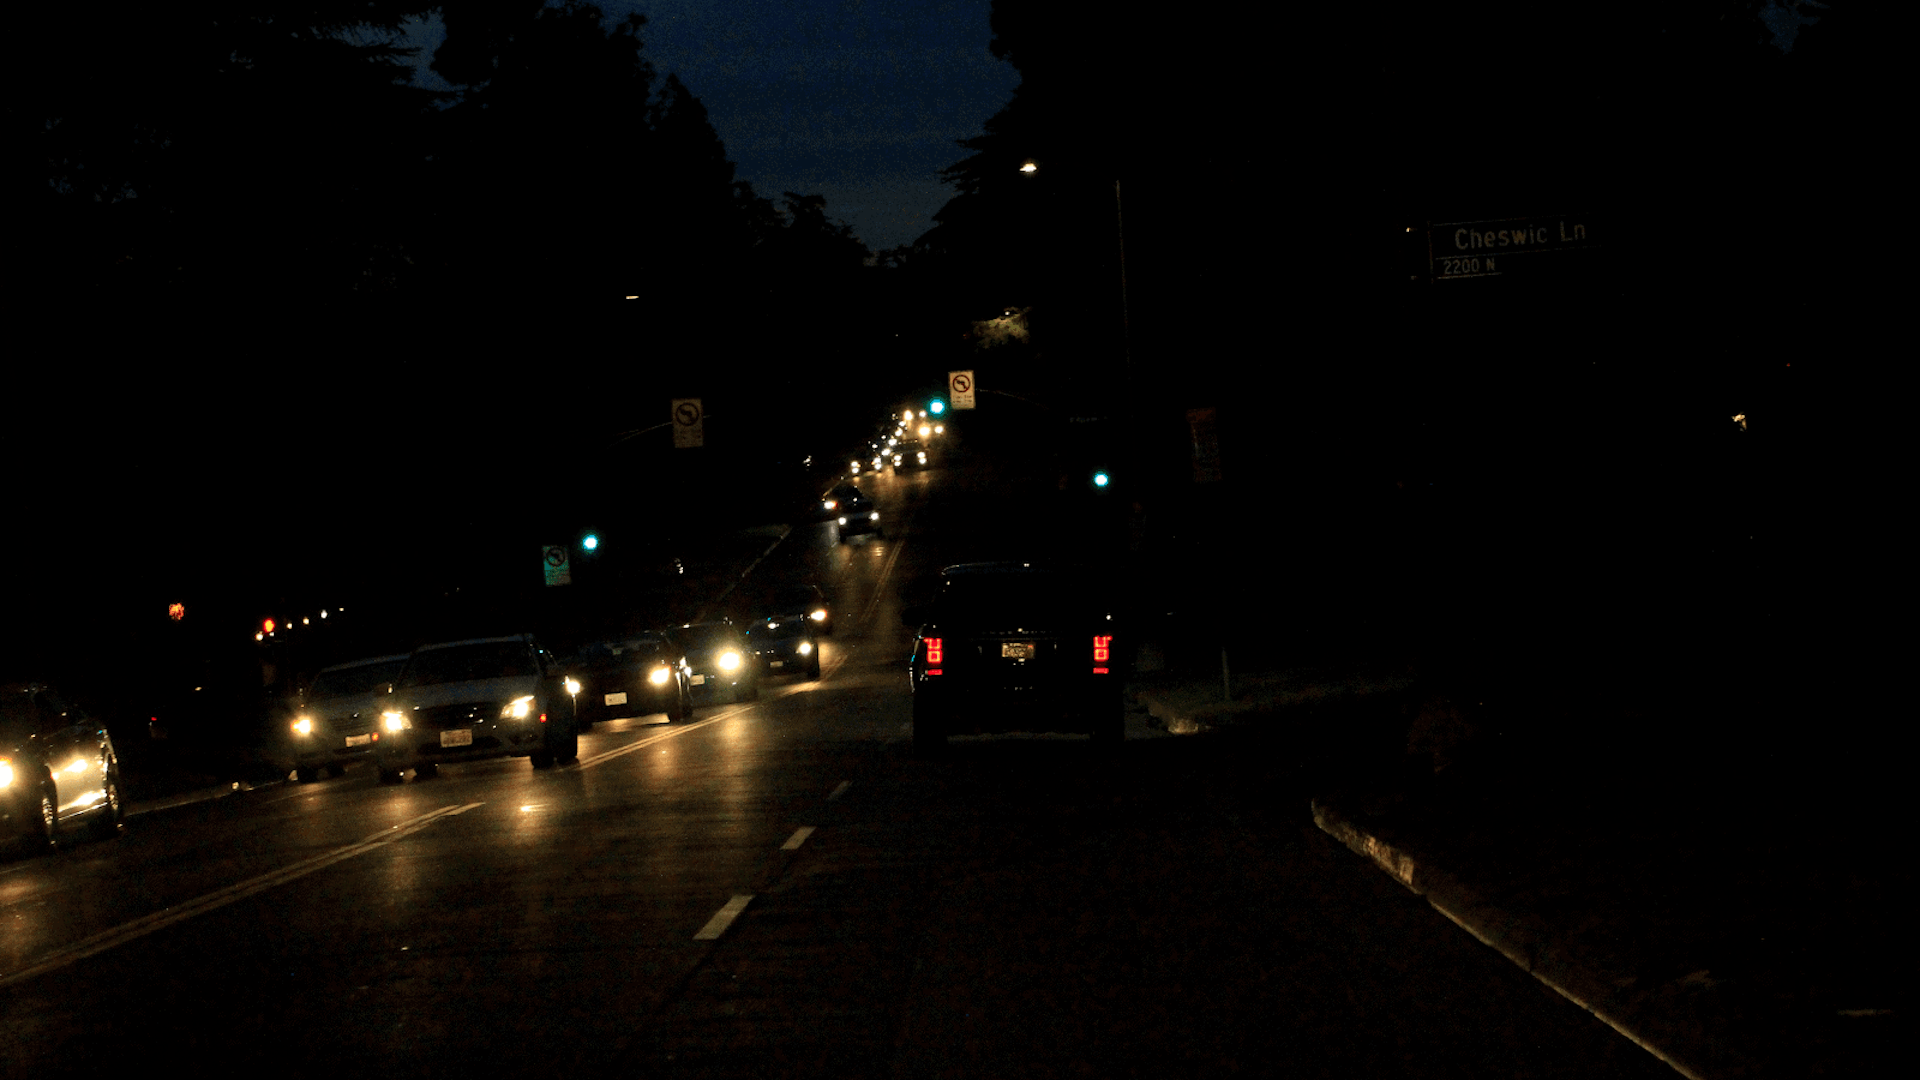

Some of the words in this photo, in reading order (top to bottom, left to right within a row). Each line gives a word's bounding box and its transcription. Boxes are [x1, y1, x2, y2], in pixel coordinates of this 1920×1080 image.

[1454, 224, 1548, 250] Cheswic
[1559, 220, 1587, 242] Ln
[1442, 258, 1480, 275] 2200
[1485, 257, 1496, 272] N
